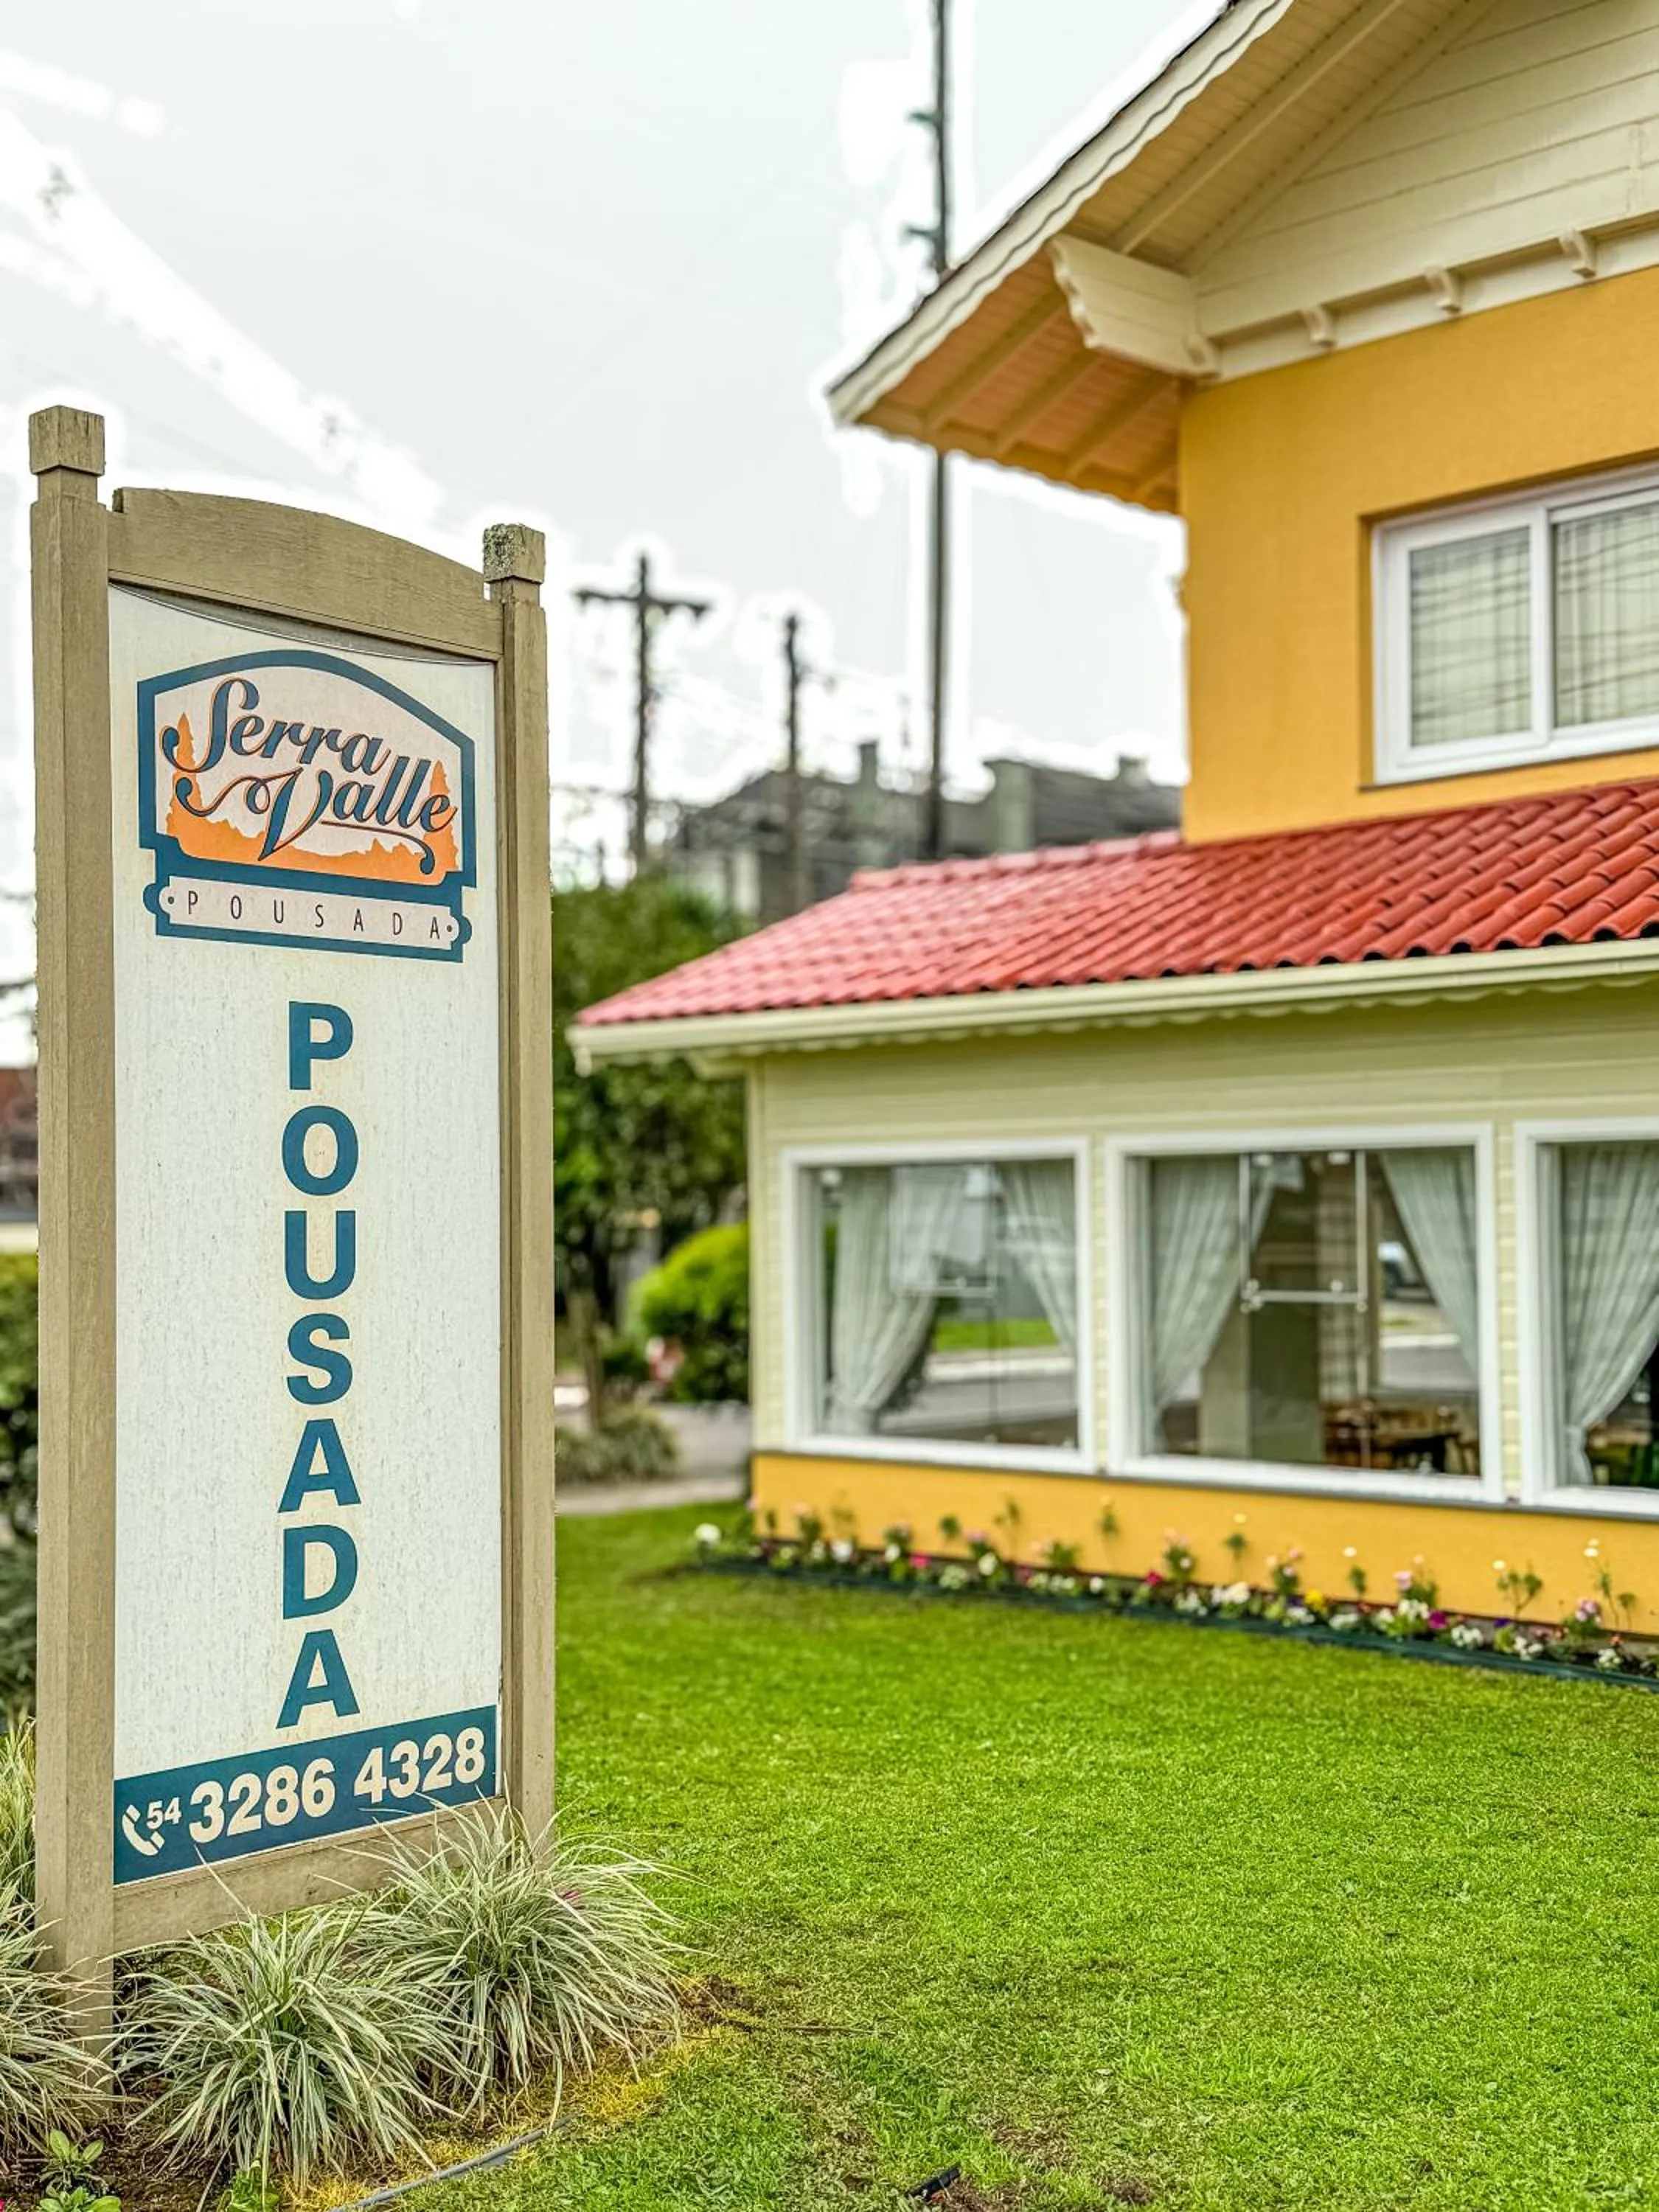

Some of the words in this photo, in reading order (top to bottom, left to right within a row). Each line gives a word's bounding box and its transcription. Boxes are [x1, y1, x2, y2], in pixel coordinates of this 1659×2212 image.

[160, 678, 391, 776] Serra
[175, 756, 458, 874] Valle
[187, 891, 440, 939] POUSADA
[276, 1000, 361, 1730] POUSADA
[147, 1797, 181, 1830] 54
[189, 1758, 335, 1843] 3286
[354, 1727, 486, 1804] 4328
